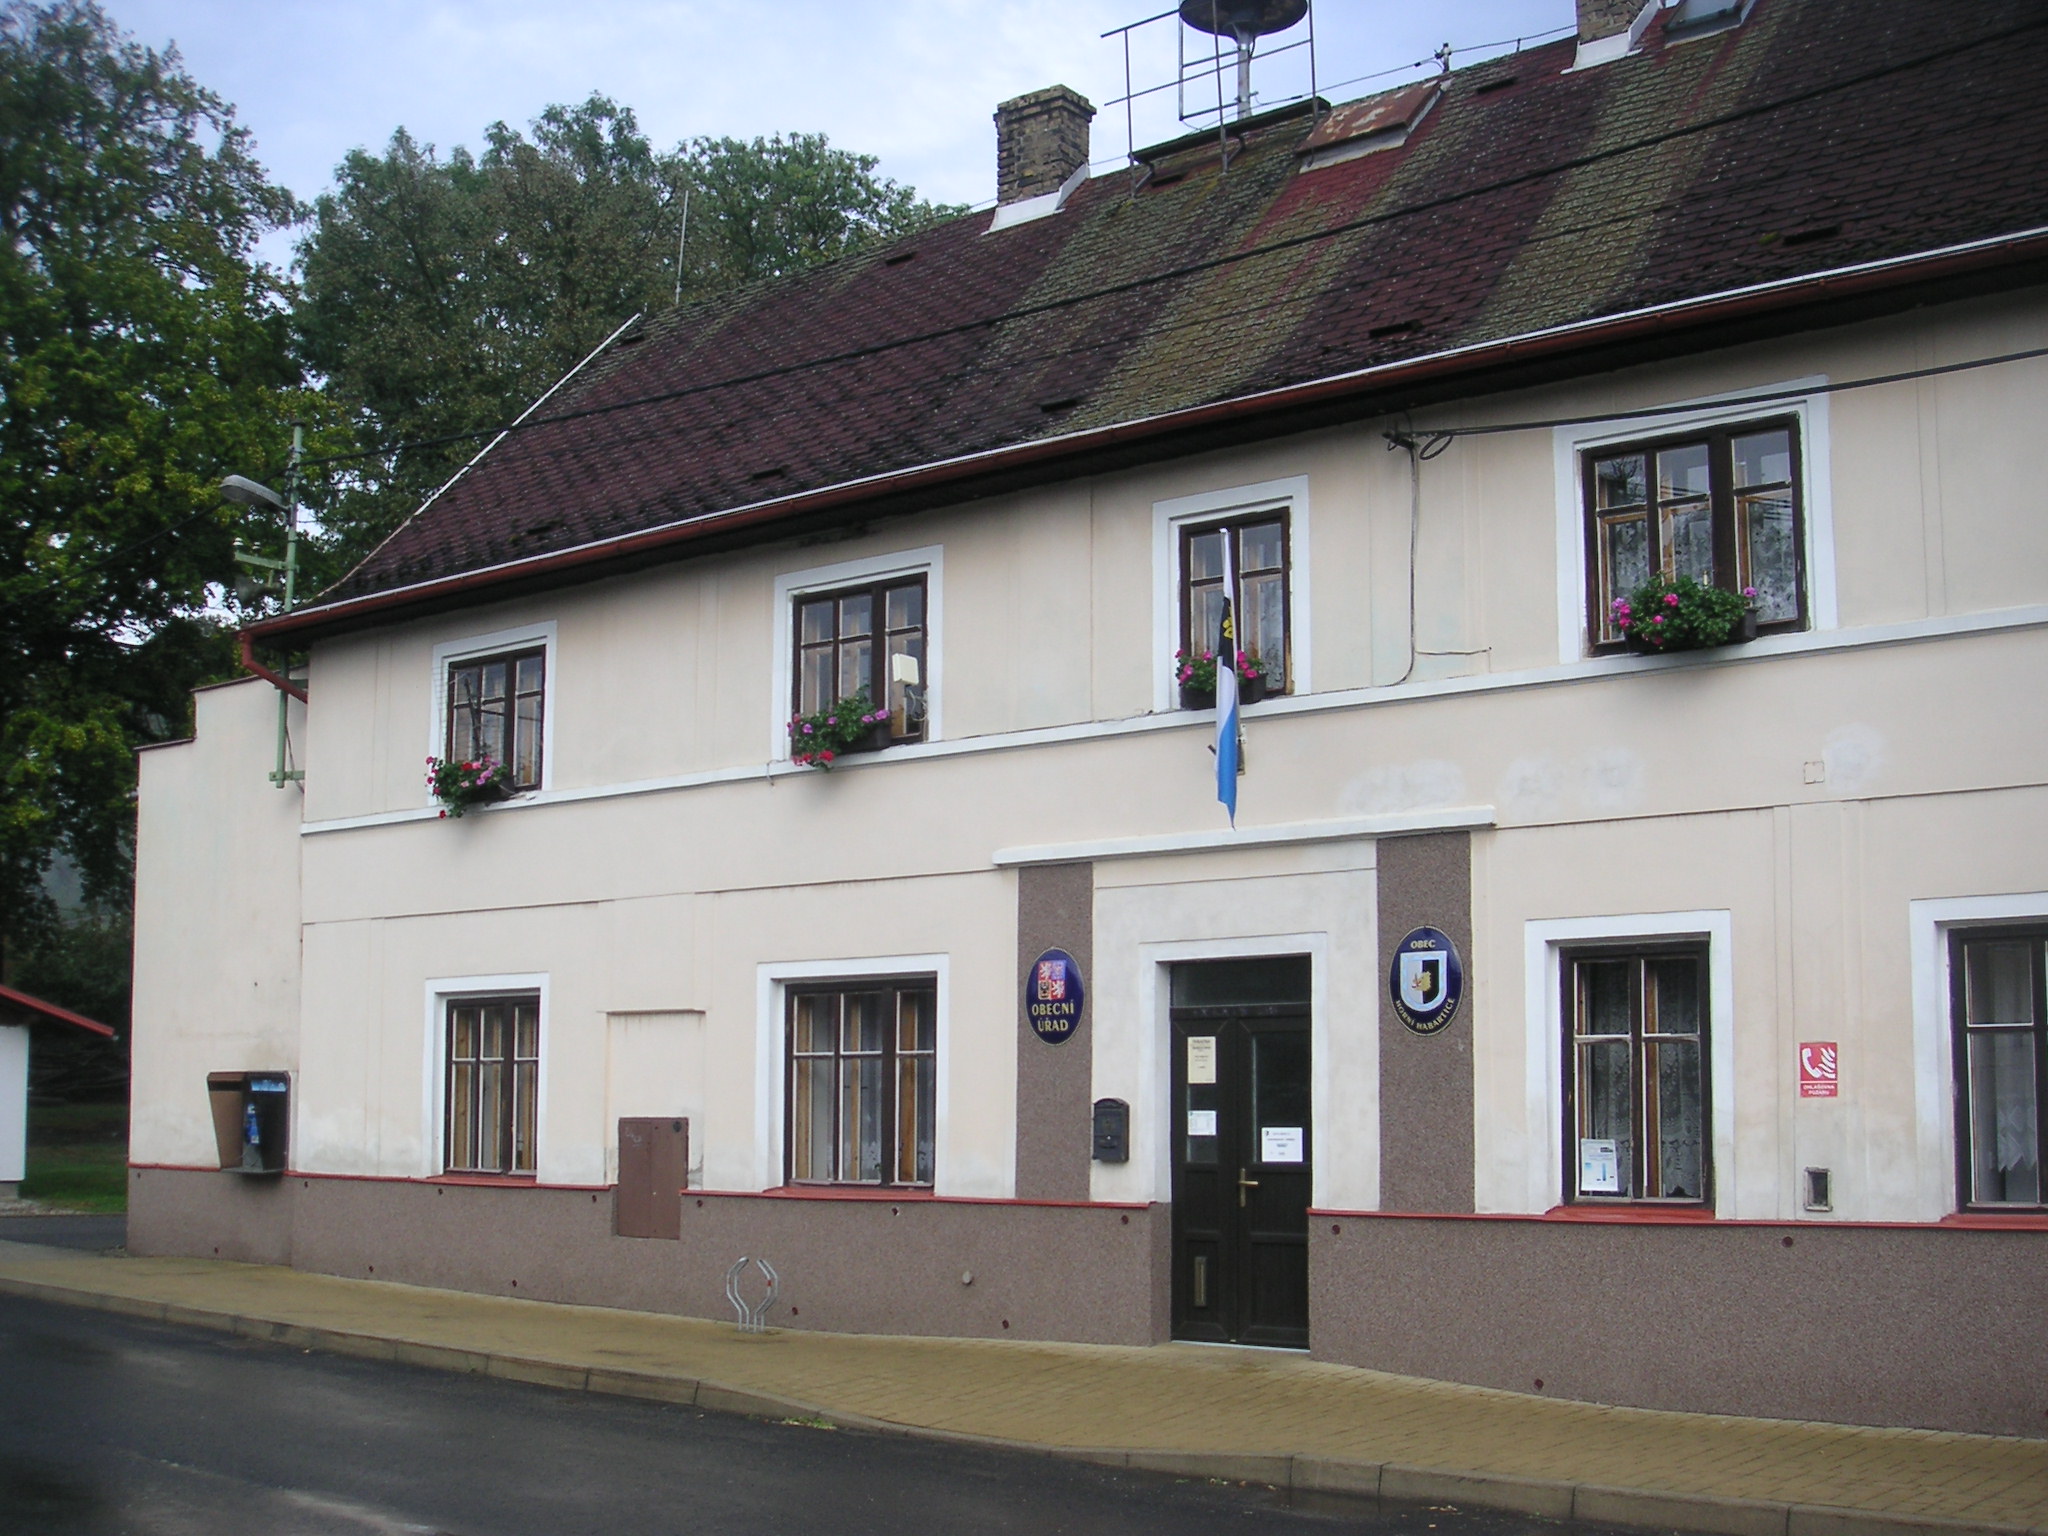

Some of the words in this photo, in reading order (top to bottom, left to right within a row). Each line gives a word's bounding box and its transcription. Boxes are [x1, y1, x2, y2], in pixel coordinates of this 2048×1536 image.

[1410, 939, 1436, 949] OBEC
[1031, 999, 1074, 1016] OBECNÍ
[1037, 1017, 1069, 1032] ÚŘAD
